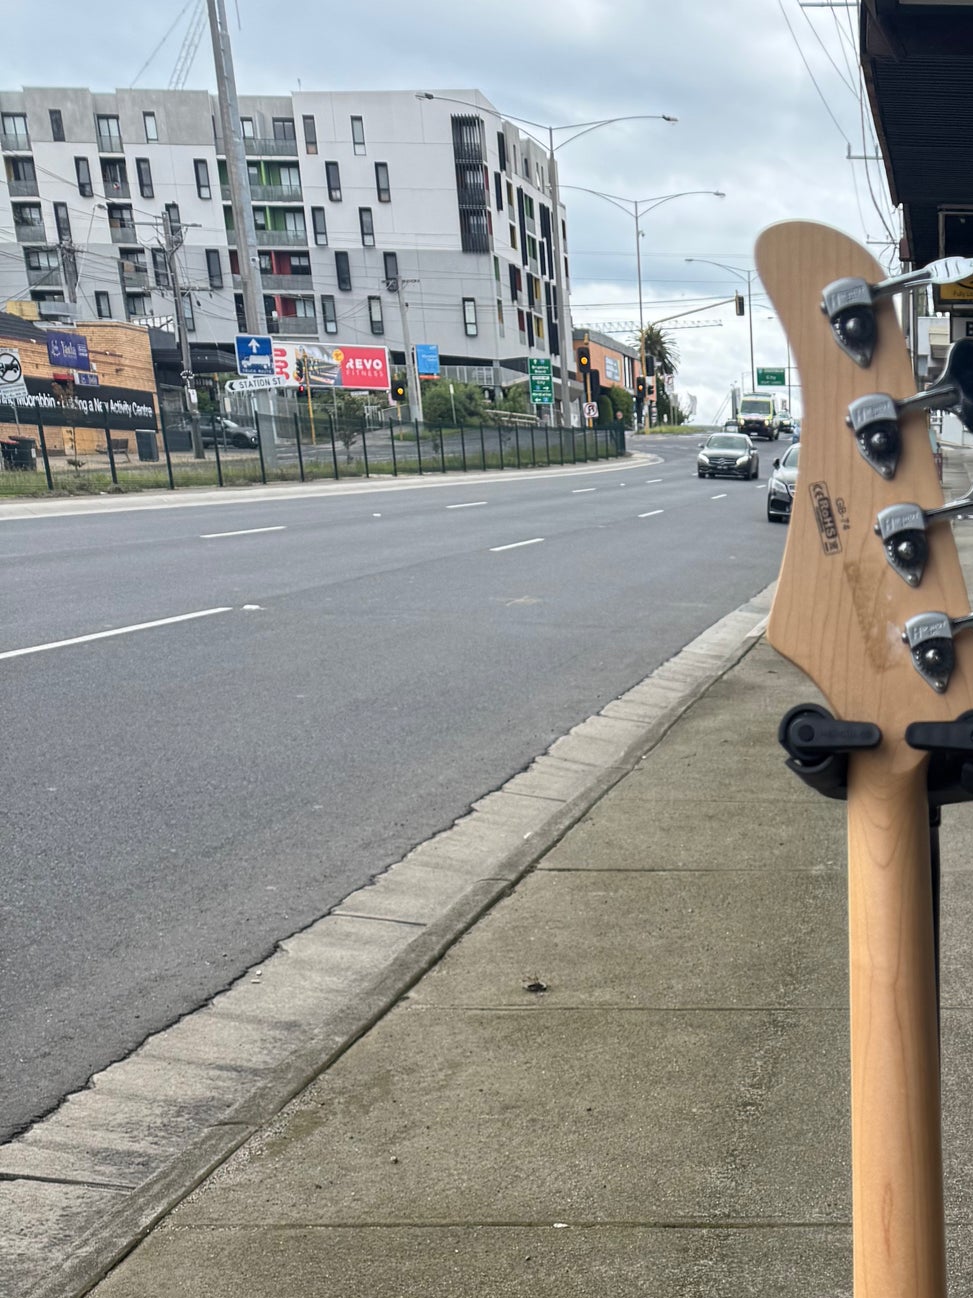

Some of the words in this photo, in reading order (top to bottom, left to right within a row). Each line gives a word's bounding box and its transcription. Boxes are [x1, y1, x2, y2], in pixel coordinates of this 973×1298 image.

[346, 358, 383, 370] REVO
[346, 370, 384, 378] FITNESS
[239, 379, 270, 389] STATION
[272, 377, 281, 386] ST
[110, 399, 132, 418] Activity
[132, 401, 153, 418] Centre
[819, 500, 836, 538] RoHS
